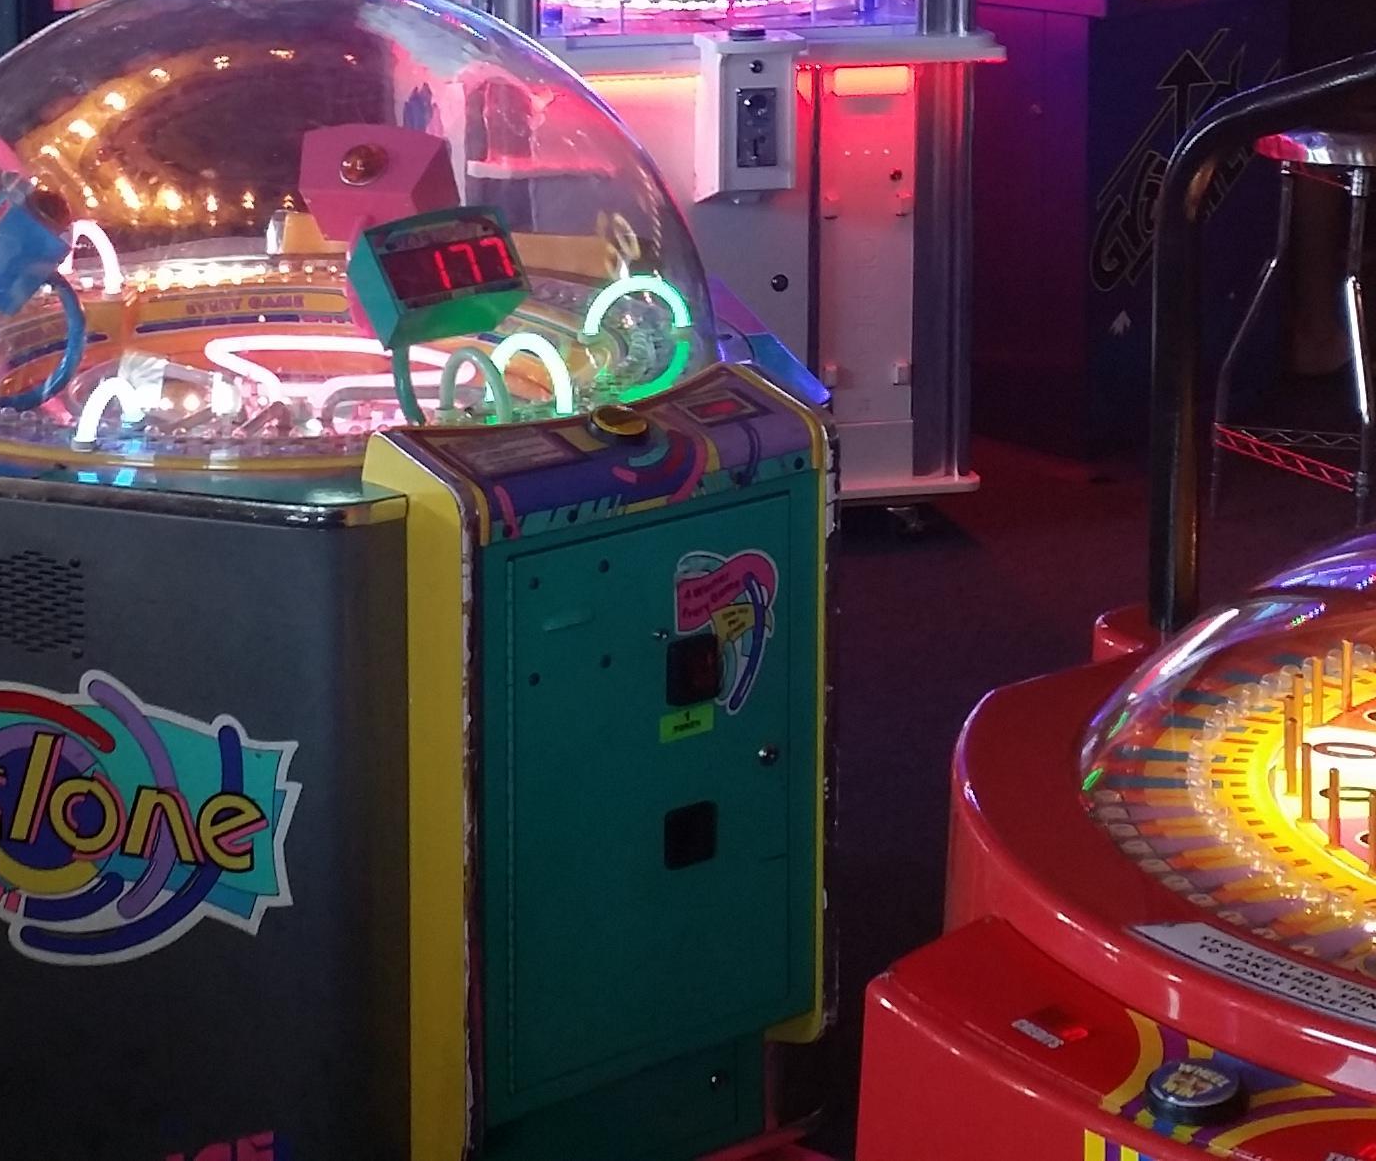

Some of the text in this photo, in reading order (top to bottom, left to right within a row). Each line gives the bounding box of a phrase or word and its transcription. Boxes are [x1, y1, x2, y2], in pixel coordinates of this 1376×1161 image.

[433, 235, 515, 290] 177
[248, 294, 304, 310] GAME
[1198, 943, 1219, 955] TO
[1223, 953, 1272, 973] MAKE
[1278, 971, 1331, 995] WHEEL
[1200, 935, 1242, 951] STOP
[1246, 949, 1295, 970] LIGHT
[1301, 969, 1329, 982] ON
[1223, 962, 1360, 1013] BONUS TICKETS
